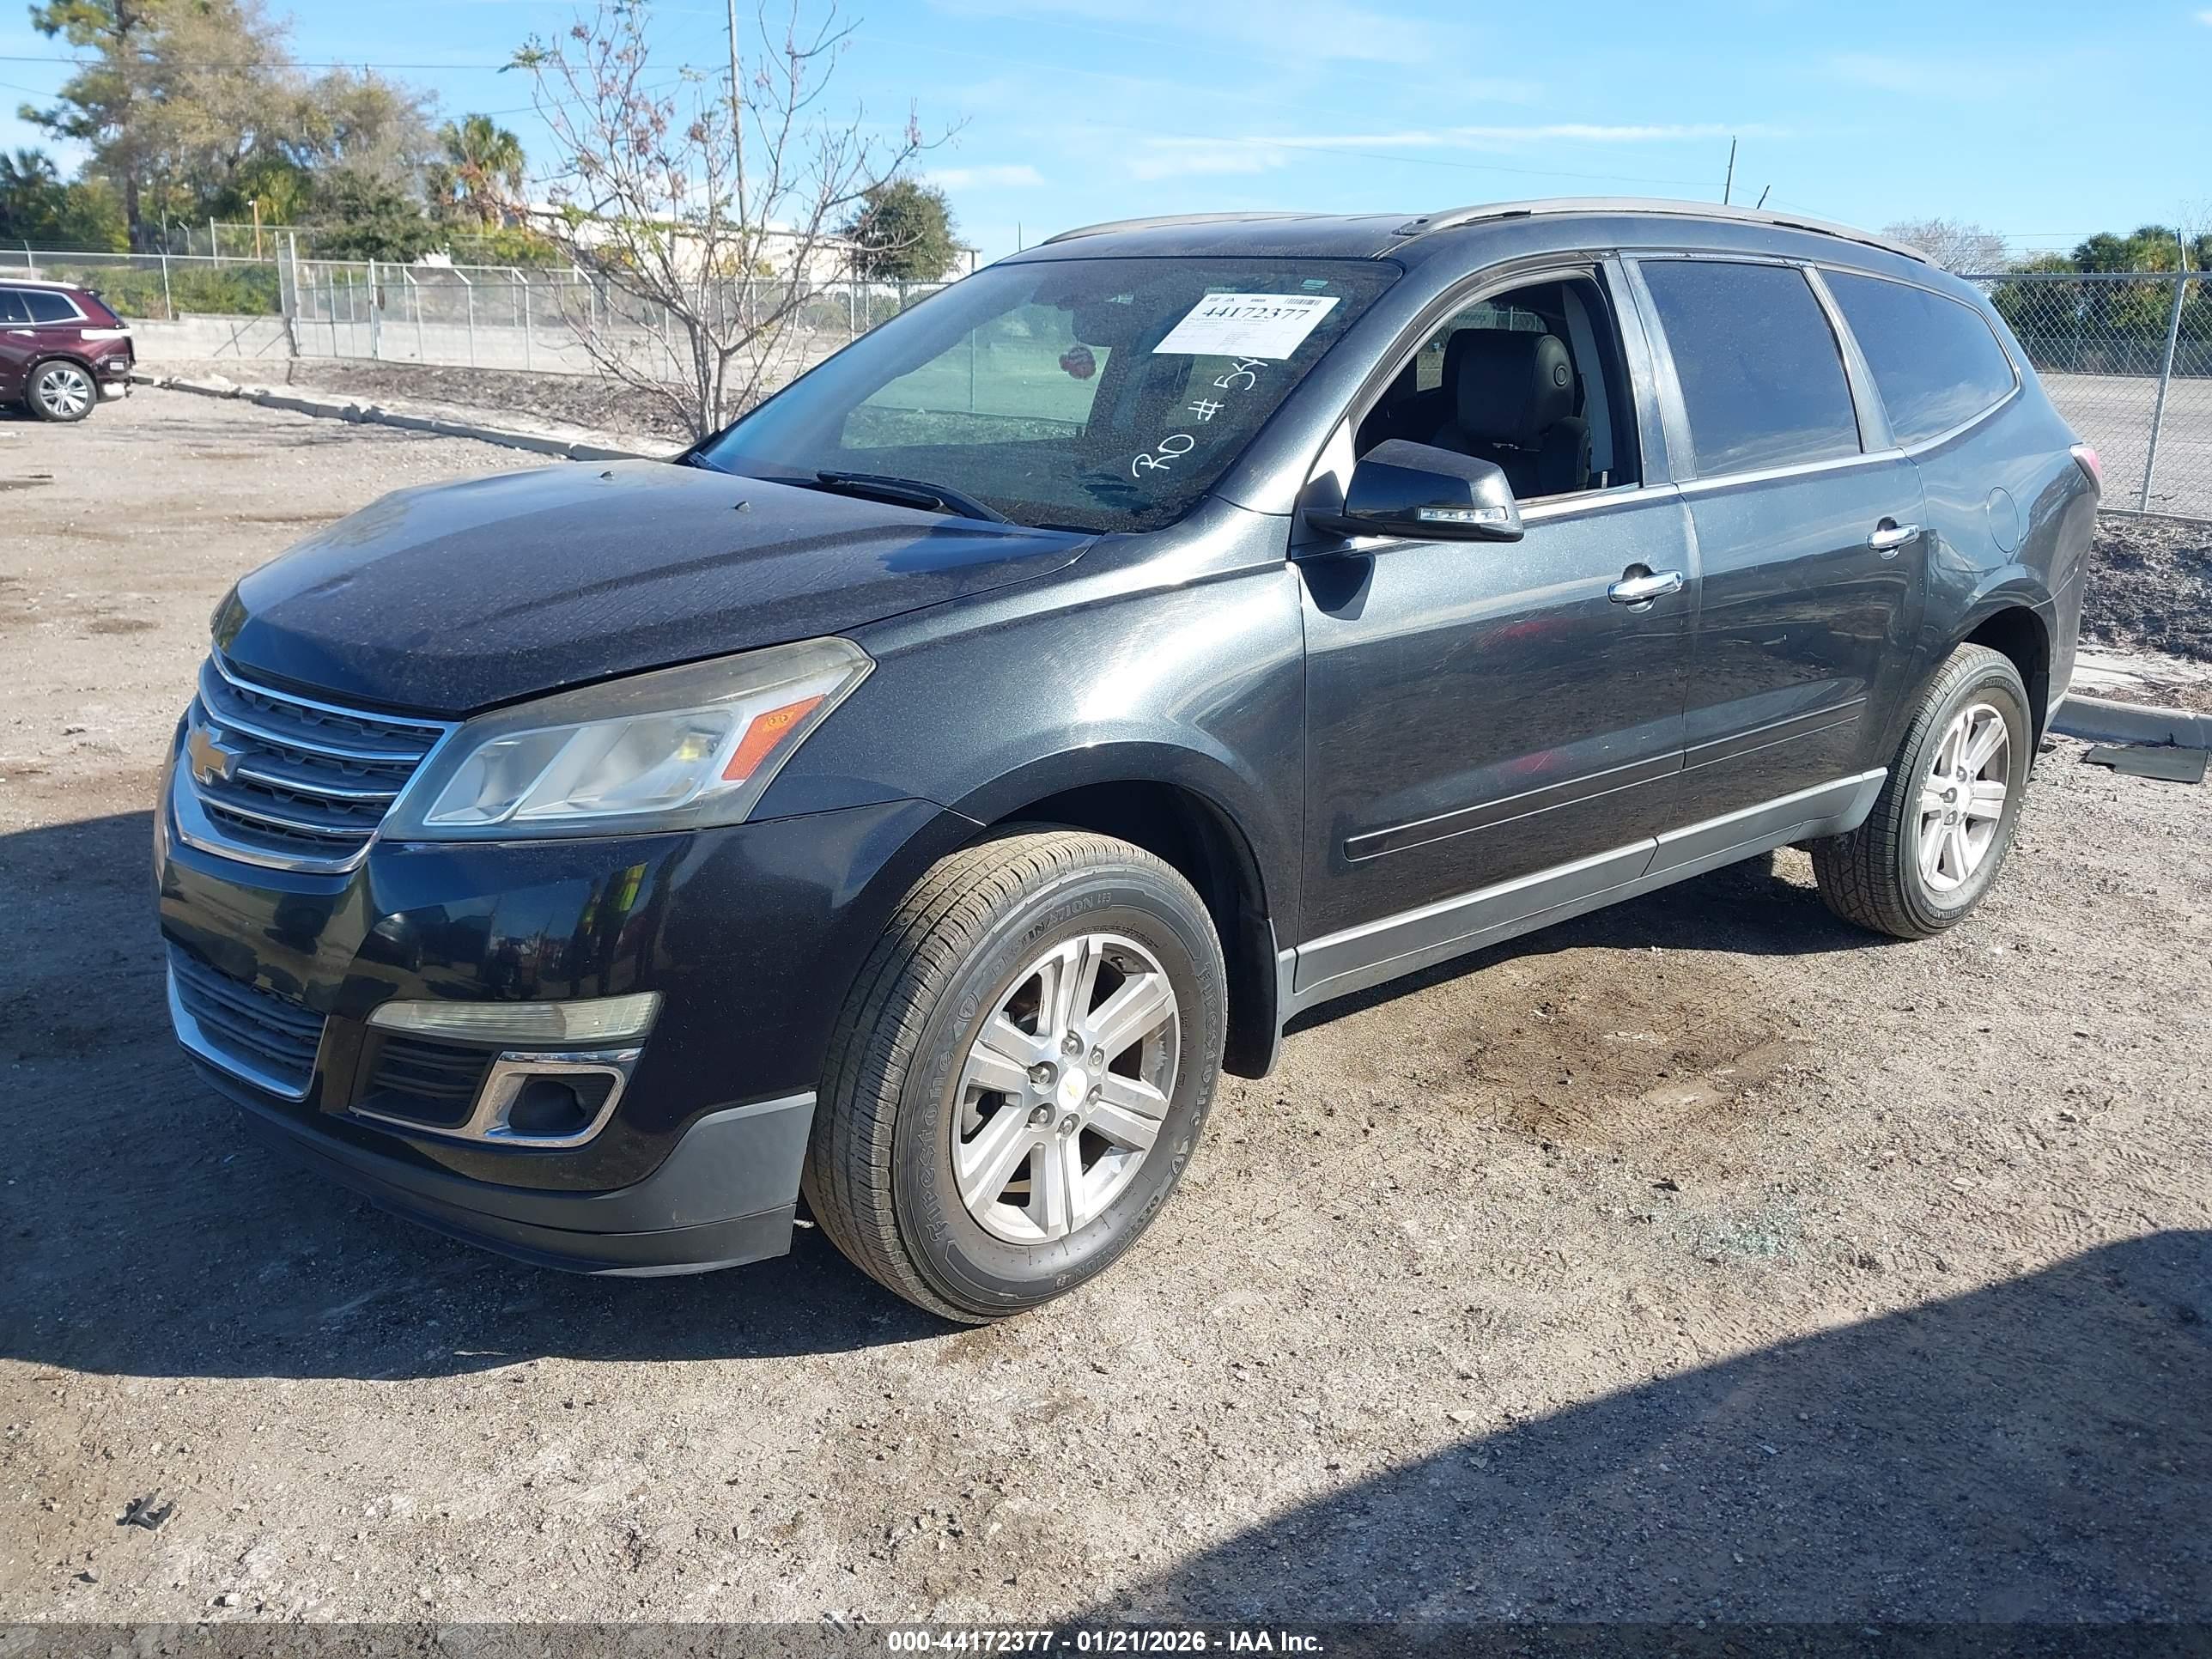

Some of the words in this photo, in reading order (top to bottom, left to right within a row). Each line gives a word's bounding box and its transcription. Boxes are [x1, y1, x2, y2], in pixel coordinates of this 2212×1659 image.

[1202, 307, 1310, 320] 44172377
[1132, 434, 1194, 477] RO
[1188, 398, 1224, 421] #
[1189, 962, 1218, 1127] Firestone
[918, 1049, 955, 1243] Firestone
